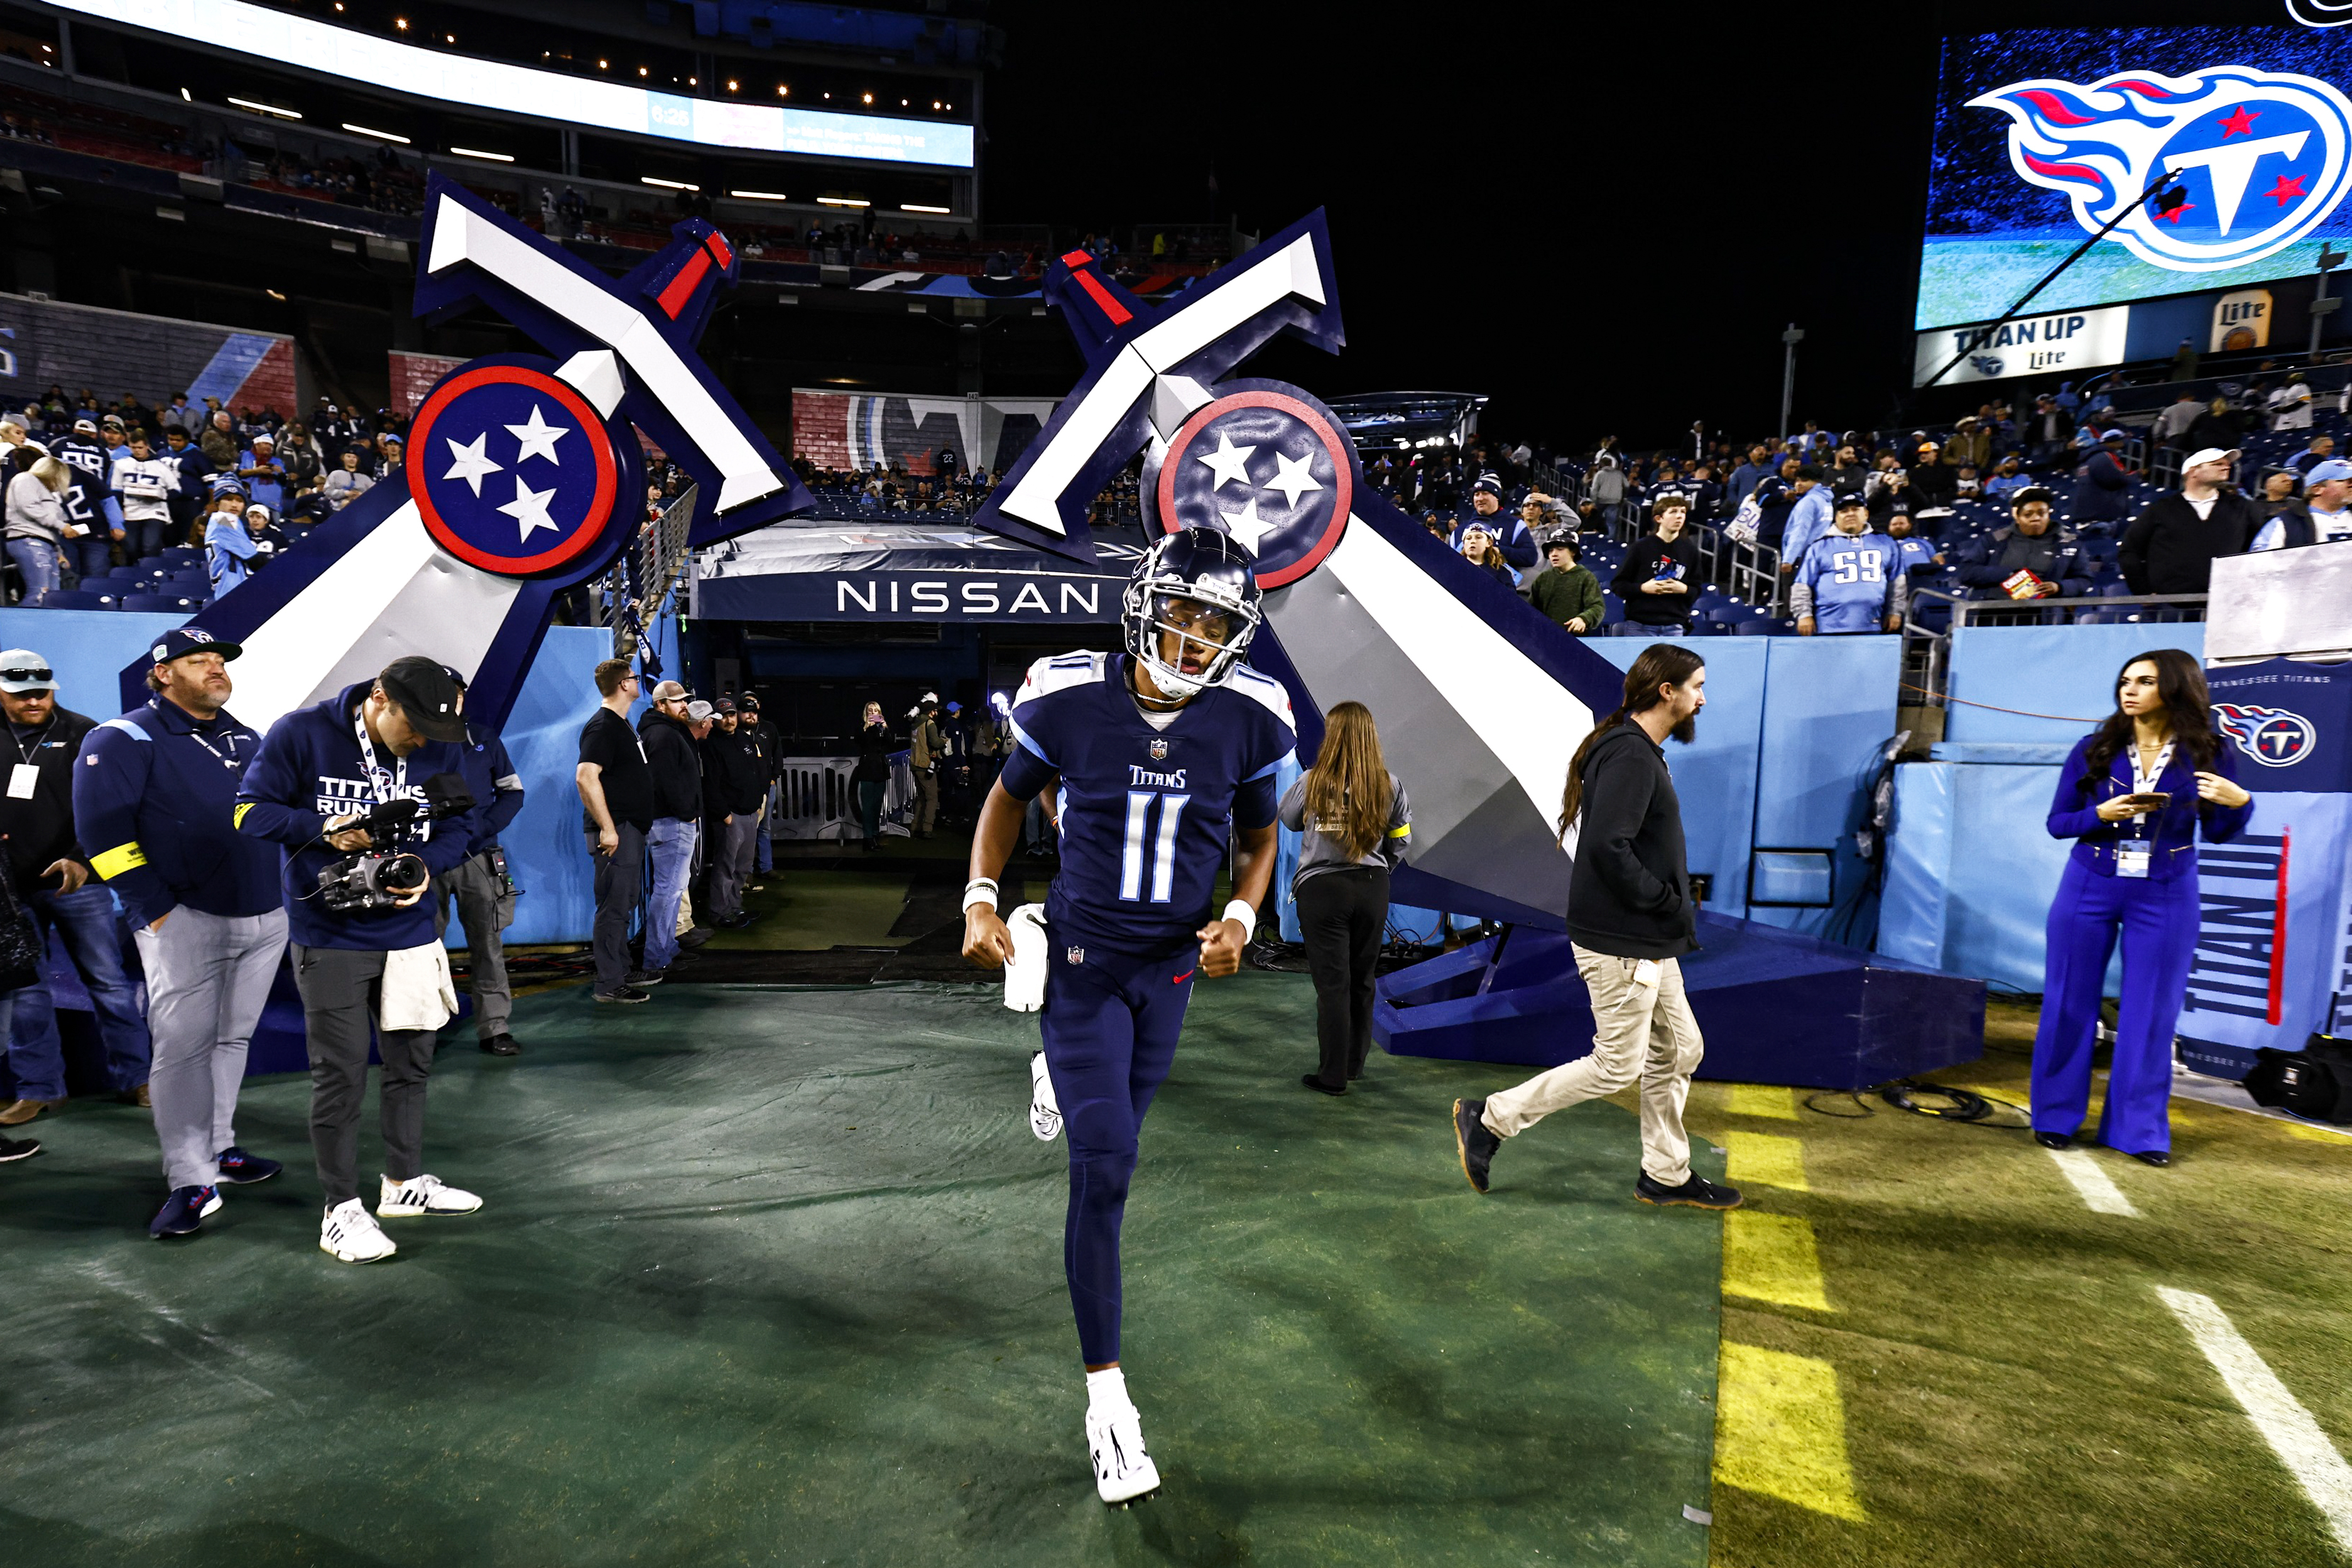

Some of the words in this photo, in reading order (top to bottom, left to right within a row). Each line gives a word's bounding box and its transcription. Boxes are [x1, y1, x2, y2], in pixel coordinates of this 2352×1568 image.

[651, 104, 690, 126] 6:25
[903, 135, 926, 148] THE
[2219, 302, 2266, 325] Lite
[2045, 315, 2086, 340] UP
[2029, 351, 2066, 369] Lite
[943, 454, 954, 463] 22
[1832, 549, 1882, 584] 59
[837, 580, 1099, 614] NISSAN
[2207, 675, 2278, 689] TENNESSEE
[2284, 675, 2331, 683] TITANS
[1129, 765, 1187, 789] TITANS
[317, 798, 371, 816] RUN
[1118, 790, 1192, 903] 11
[2184, 892, 2278, 1020] TITAN
